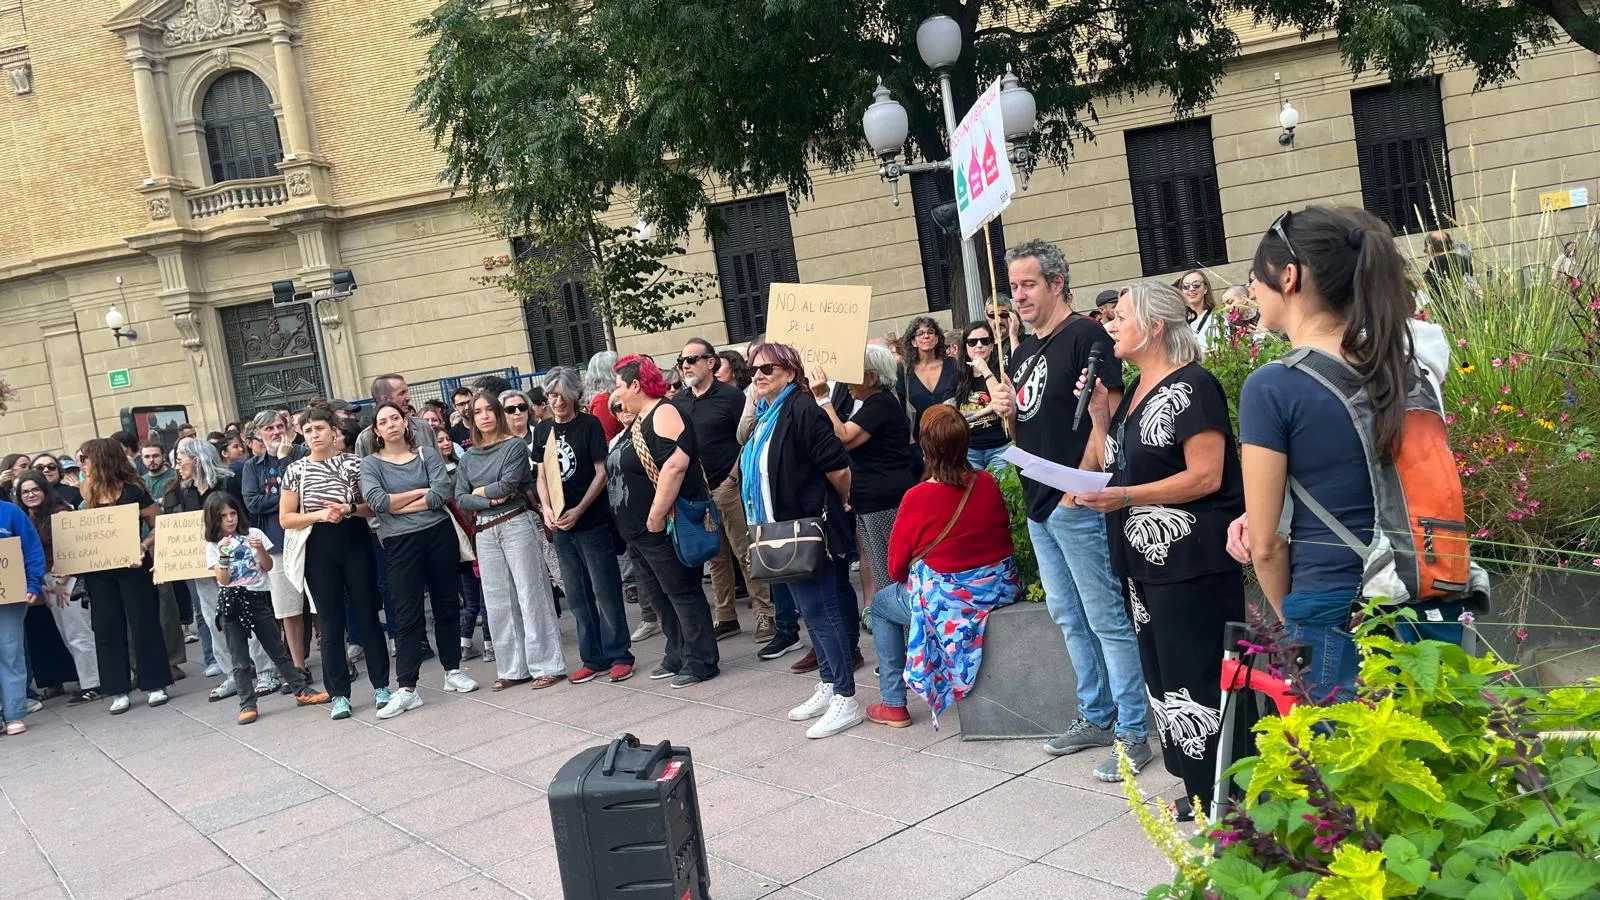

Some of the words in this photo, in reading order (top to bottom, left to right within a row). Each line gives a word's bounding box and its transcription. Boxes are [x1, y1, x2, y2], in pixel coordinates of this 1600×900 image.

[775, 293, 796, 312] NO
[802, 300, 815, 313] AL
[819, 300, 859, 314] NEGOCIO
[786, 320, 800, 333] DE
[805, 322, 815, 332] LA
[61, 517, 75, 530] EL
[167, 535, 180, 544] POR
[183, 534, 196, 543] LAS
[68, 550, 76, 559] EL
[78, 546, 98, 558] GRAN
[89, 556, 131, 569] INVASOR
[164, 562, 177, 572] POR
[179, 561, 192, 570] LOS
